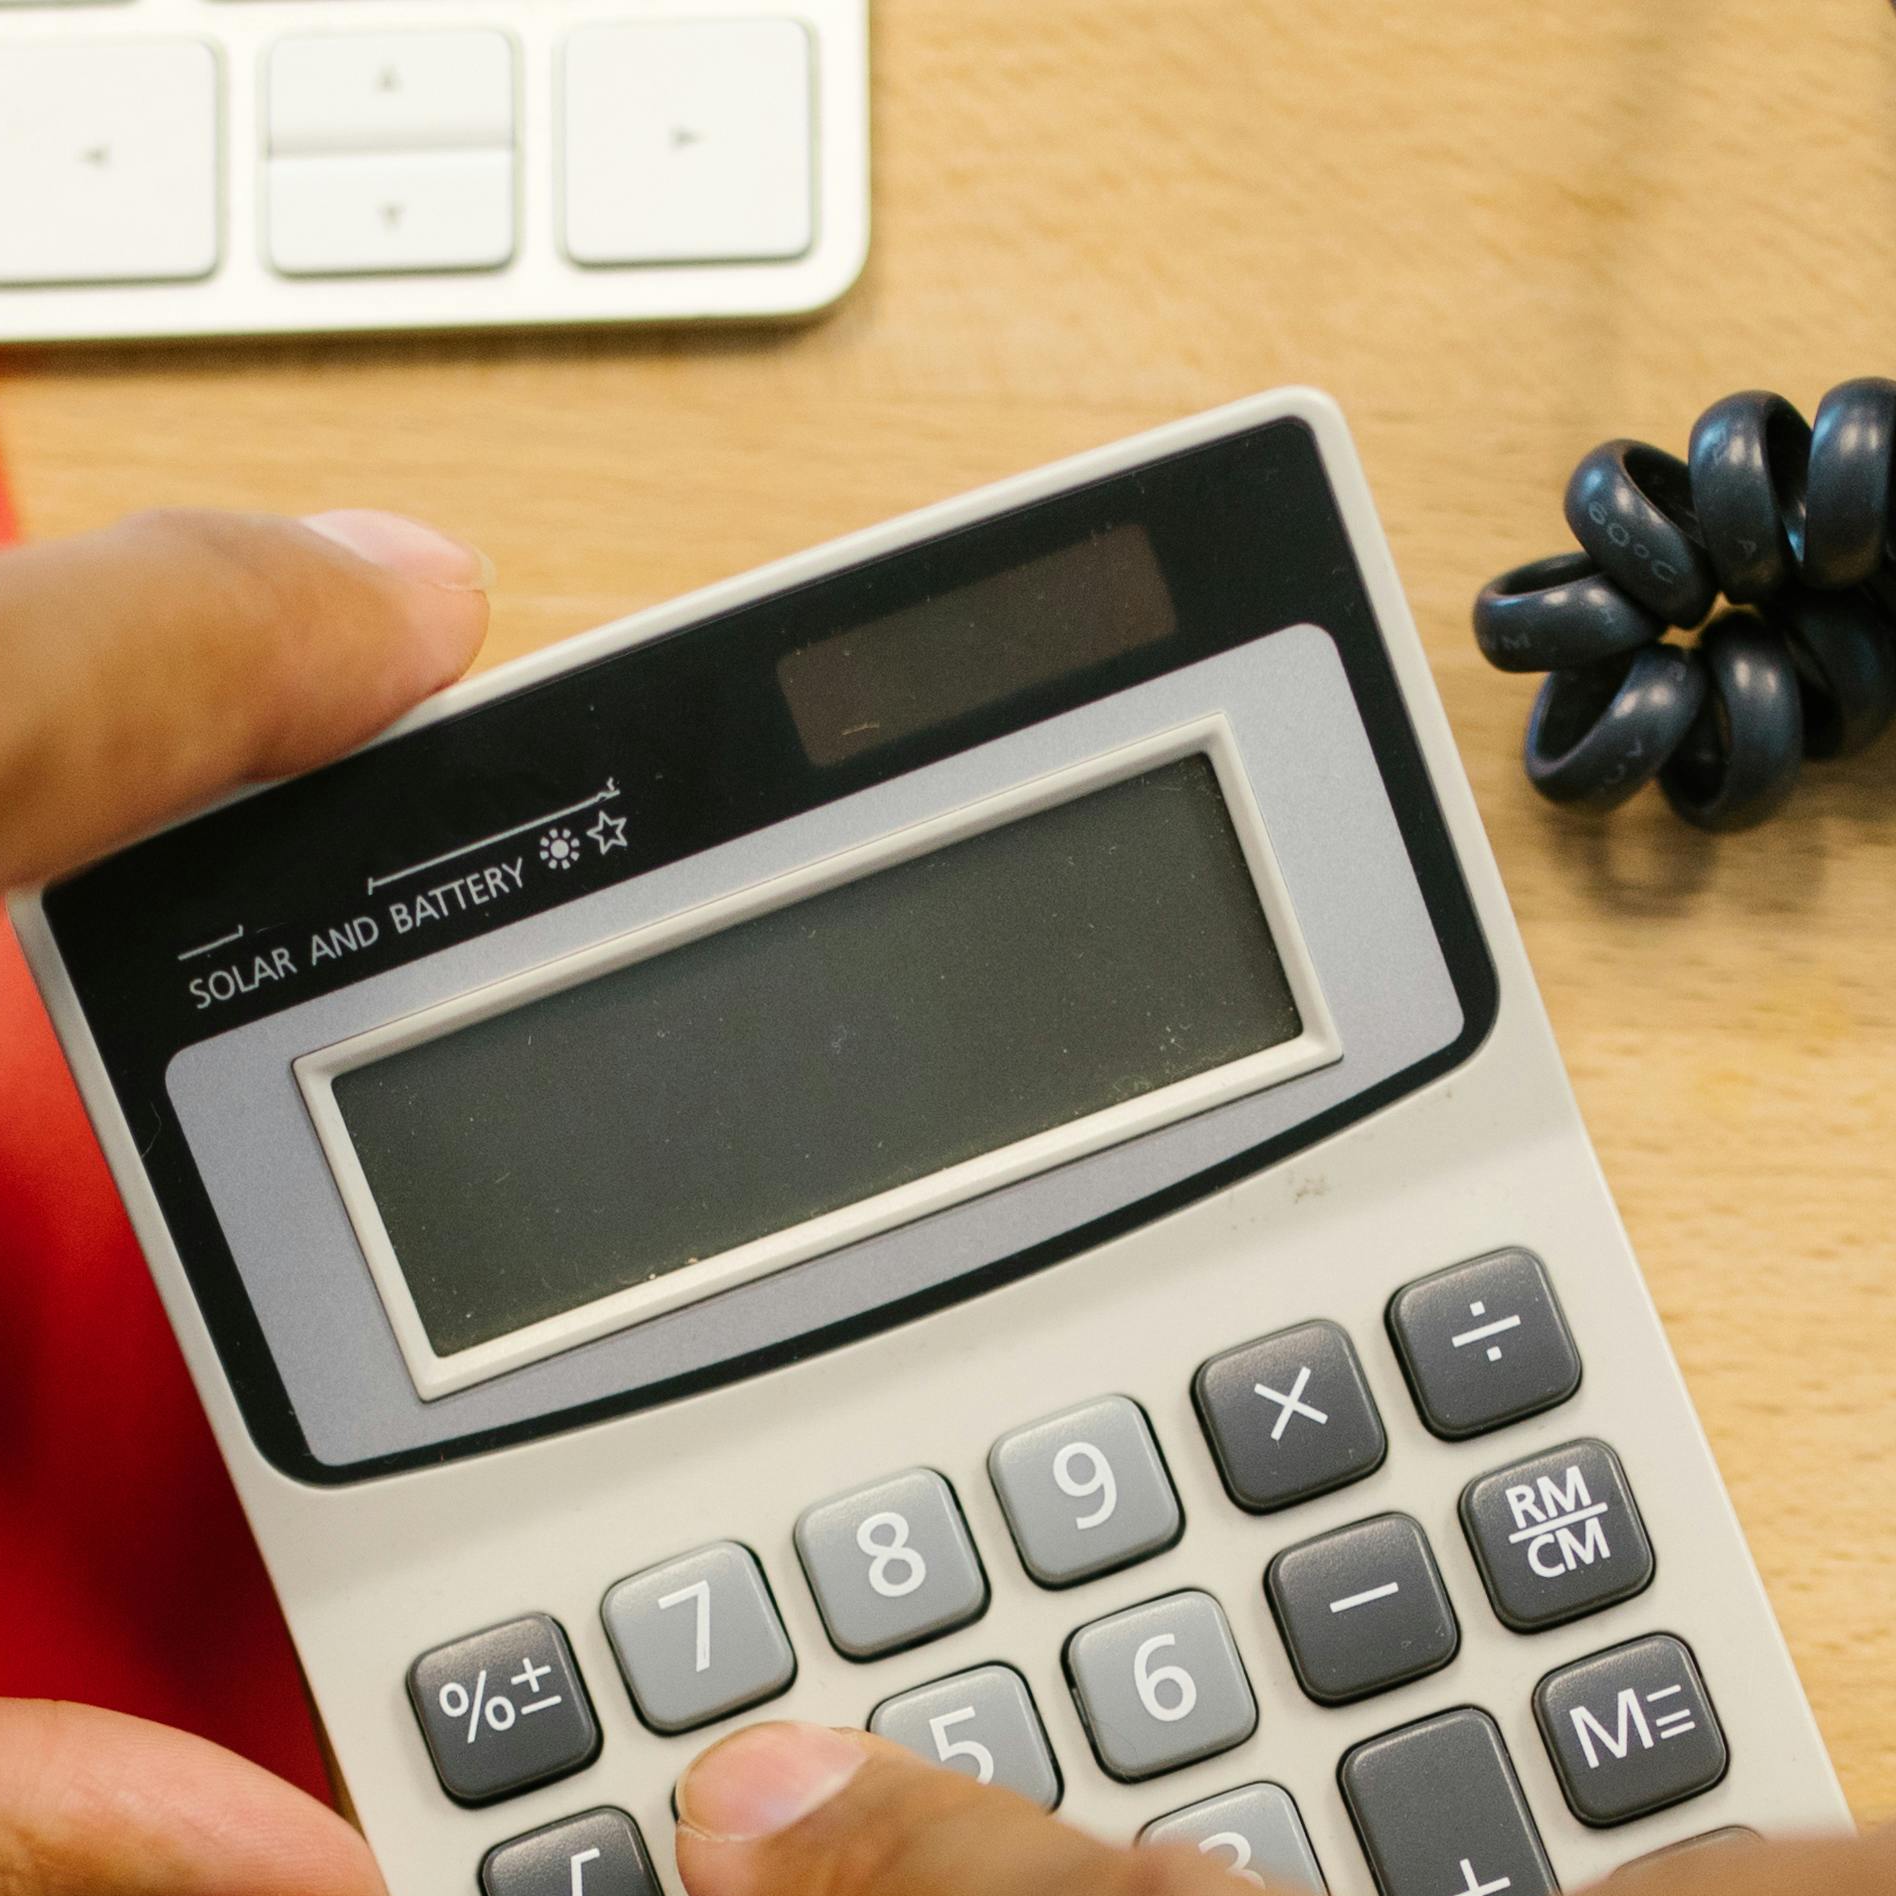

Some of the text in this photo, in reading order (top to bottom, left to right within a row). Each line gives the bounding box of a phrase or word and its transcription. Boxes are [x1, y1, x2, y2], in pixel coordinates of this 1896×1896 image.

[189, 856, 525, 1009] SOLAR AND BATTERY
[1053, 1441, 1118, 1530] 9
[1506, 1465, 1593, 1530] RM
[856, 1511, 927, 1598] 8
[1526, 1517, 1611, 1579] CM
[658, 1580, 711, 1672] 7
[1133, 1633, 1198, 1722] 6
